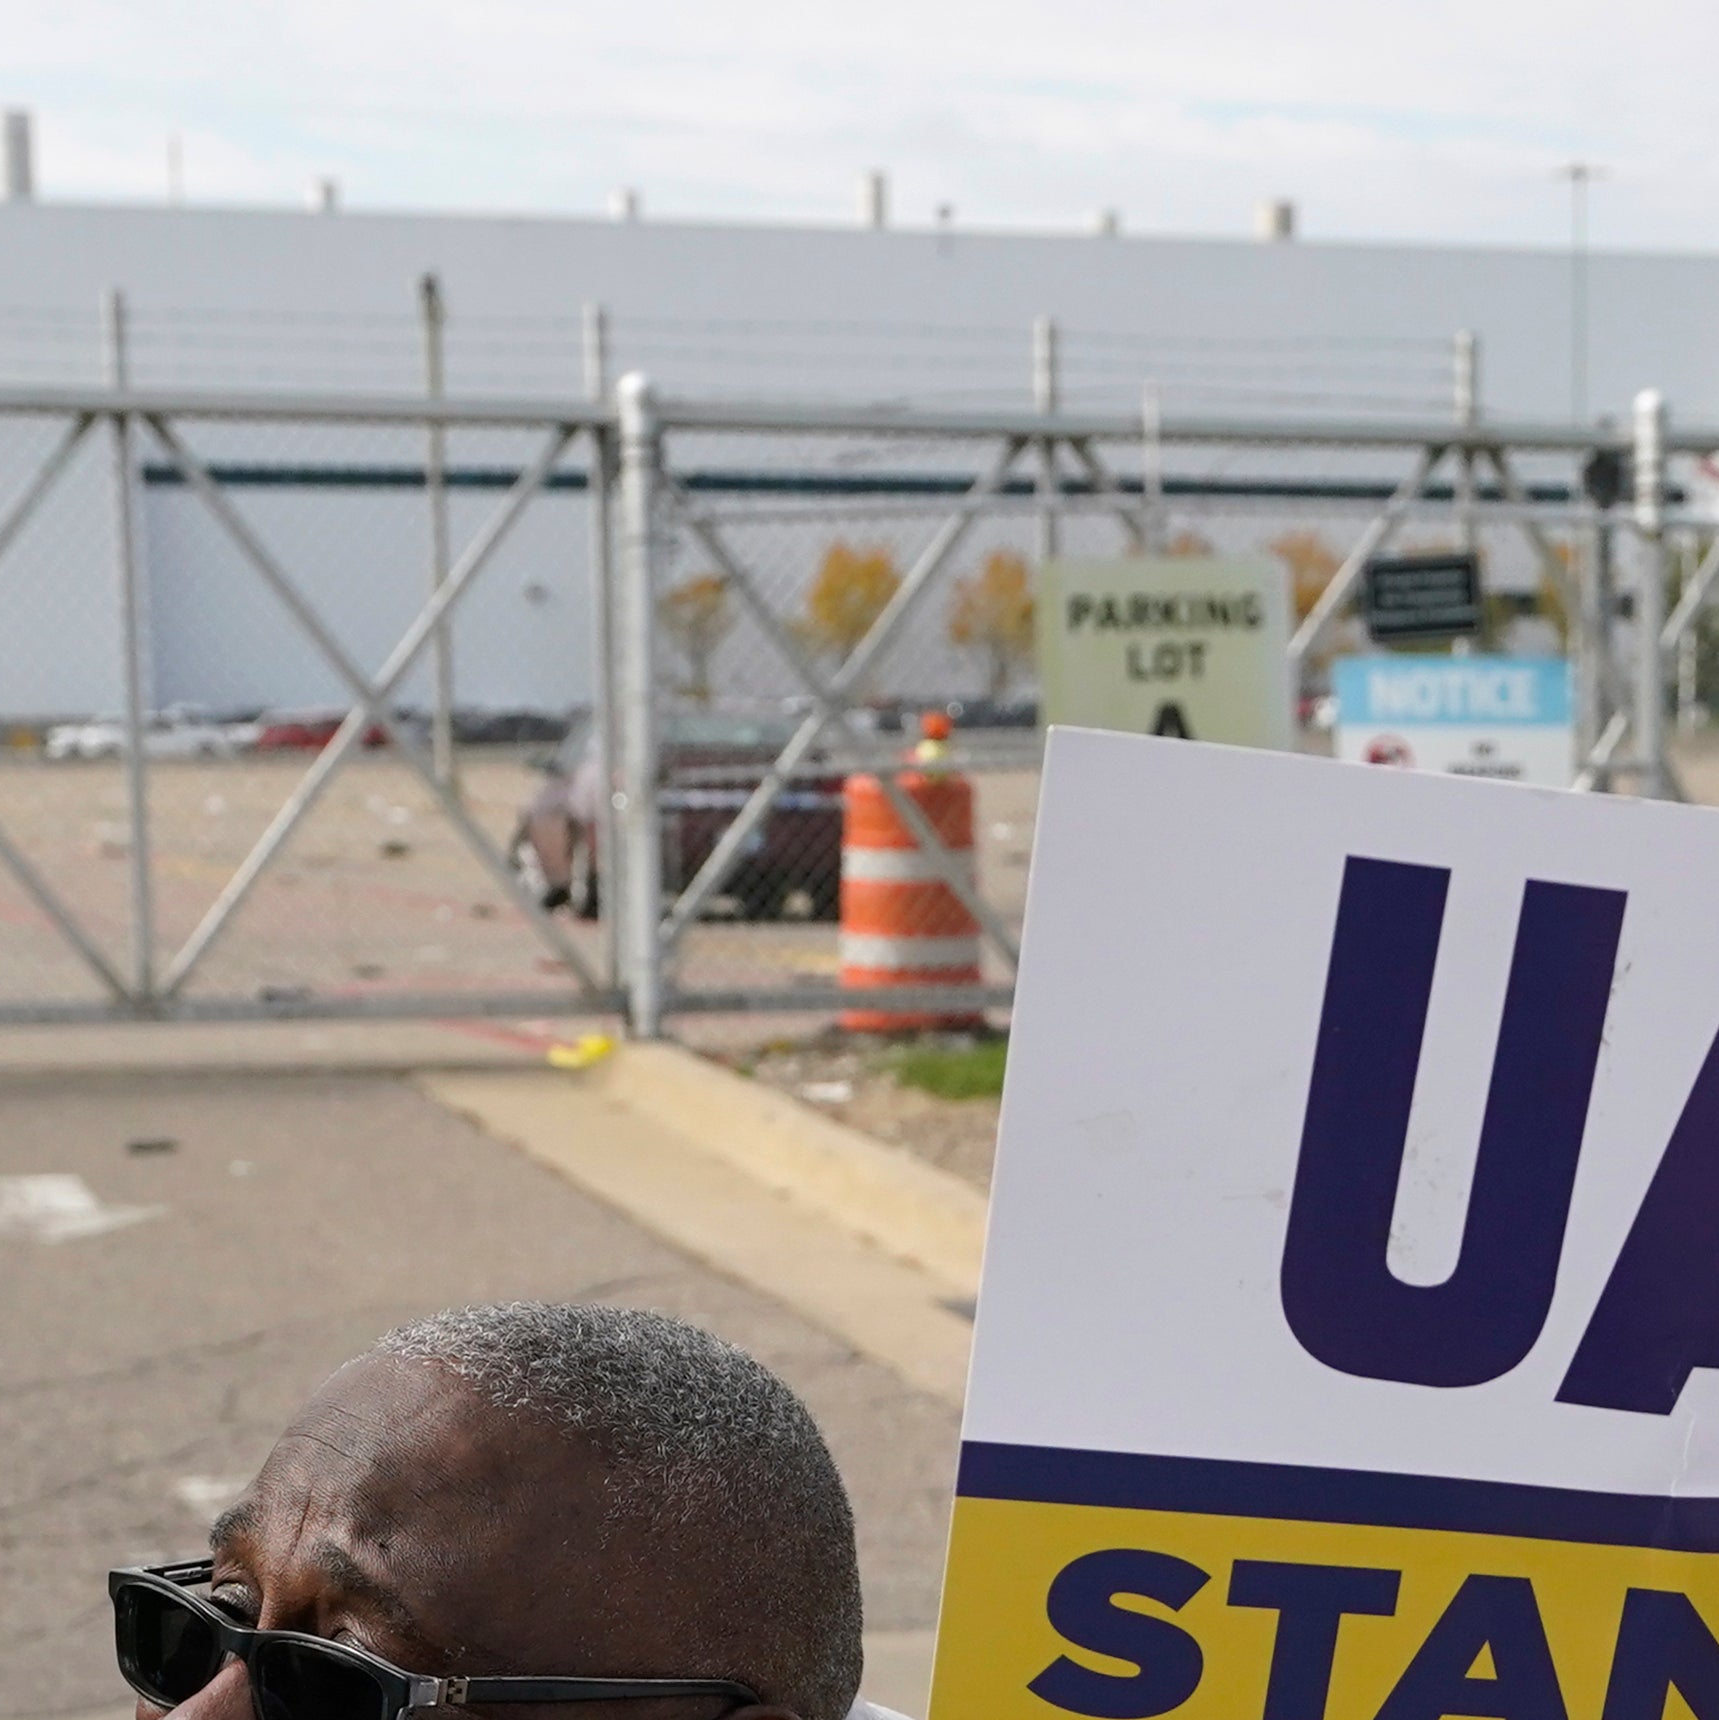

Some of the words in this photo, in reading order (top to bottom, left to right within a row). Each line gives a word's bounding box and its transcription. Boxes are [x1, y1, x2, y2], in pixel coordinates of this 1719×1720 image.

[1065, 591, 1262, 632] PARKING
[1124, 640, 1209, 682] LOT
[1368, 668, 1535, 719] NOTICE
